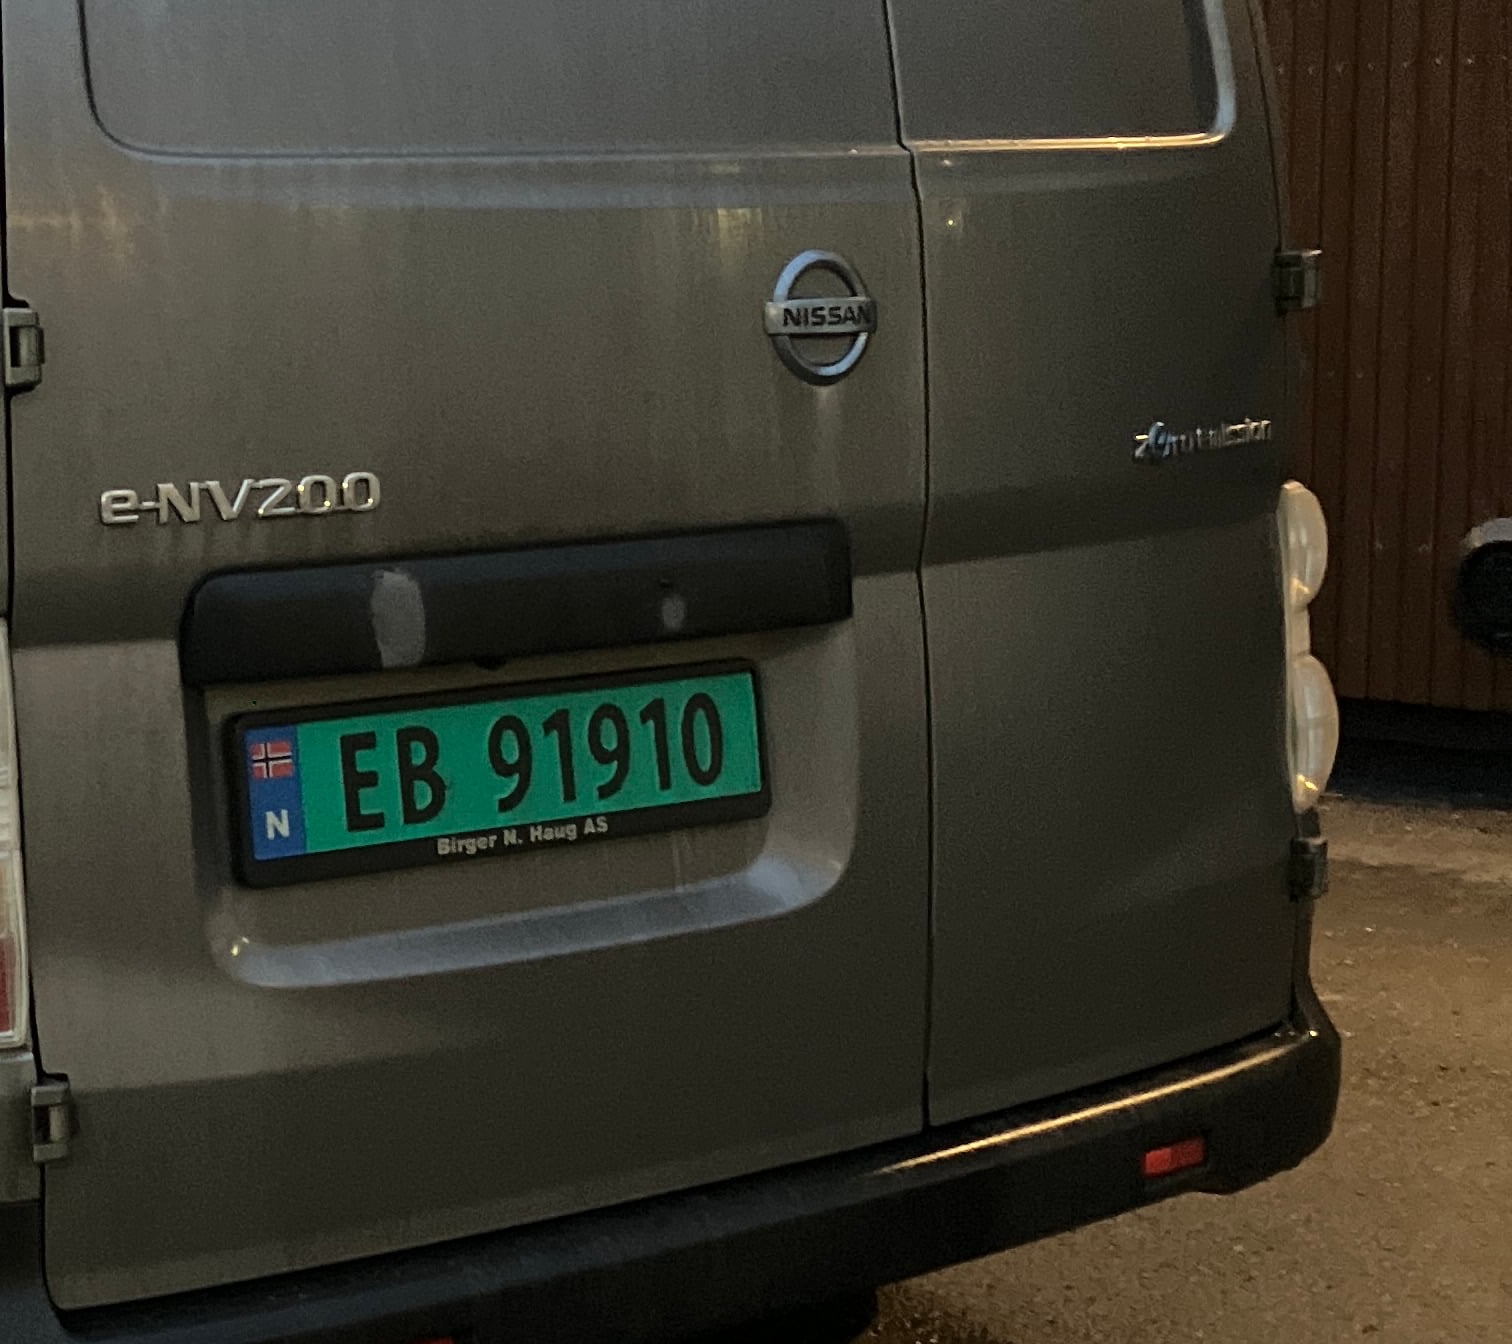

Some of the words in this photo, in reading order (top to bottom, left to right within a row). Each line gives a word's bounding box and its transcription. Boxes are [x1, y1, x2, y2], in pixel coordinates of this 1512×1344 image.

[782, 306, 872, 328] NISSAN
[100, 471, 381, 524] e-NV200
[339, 725, 447, 832] EB
[487, 692, 724, 813] 91910
[265, 809, 290, 840] N
[437, 834, 497, 855] Birger
[530, 823, 577, 841] Haug
[584, 816, 608, 834] AS
